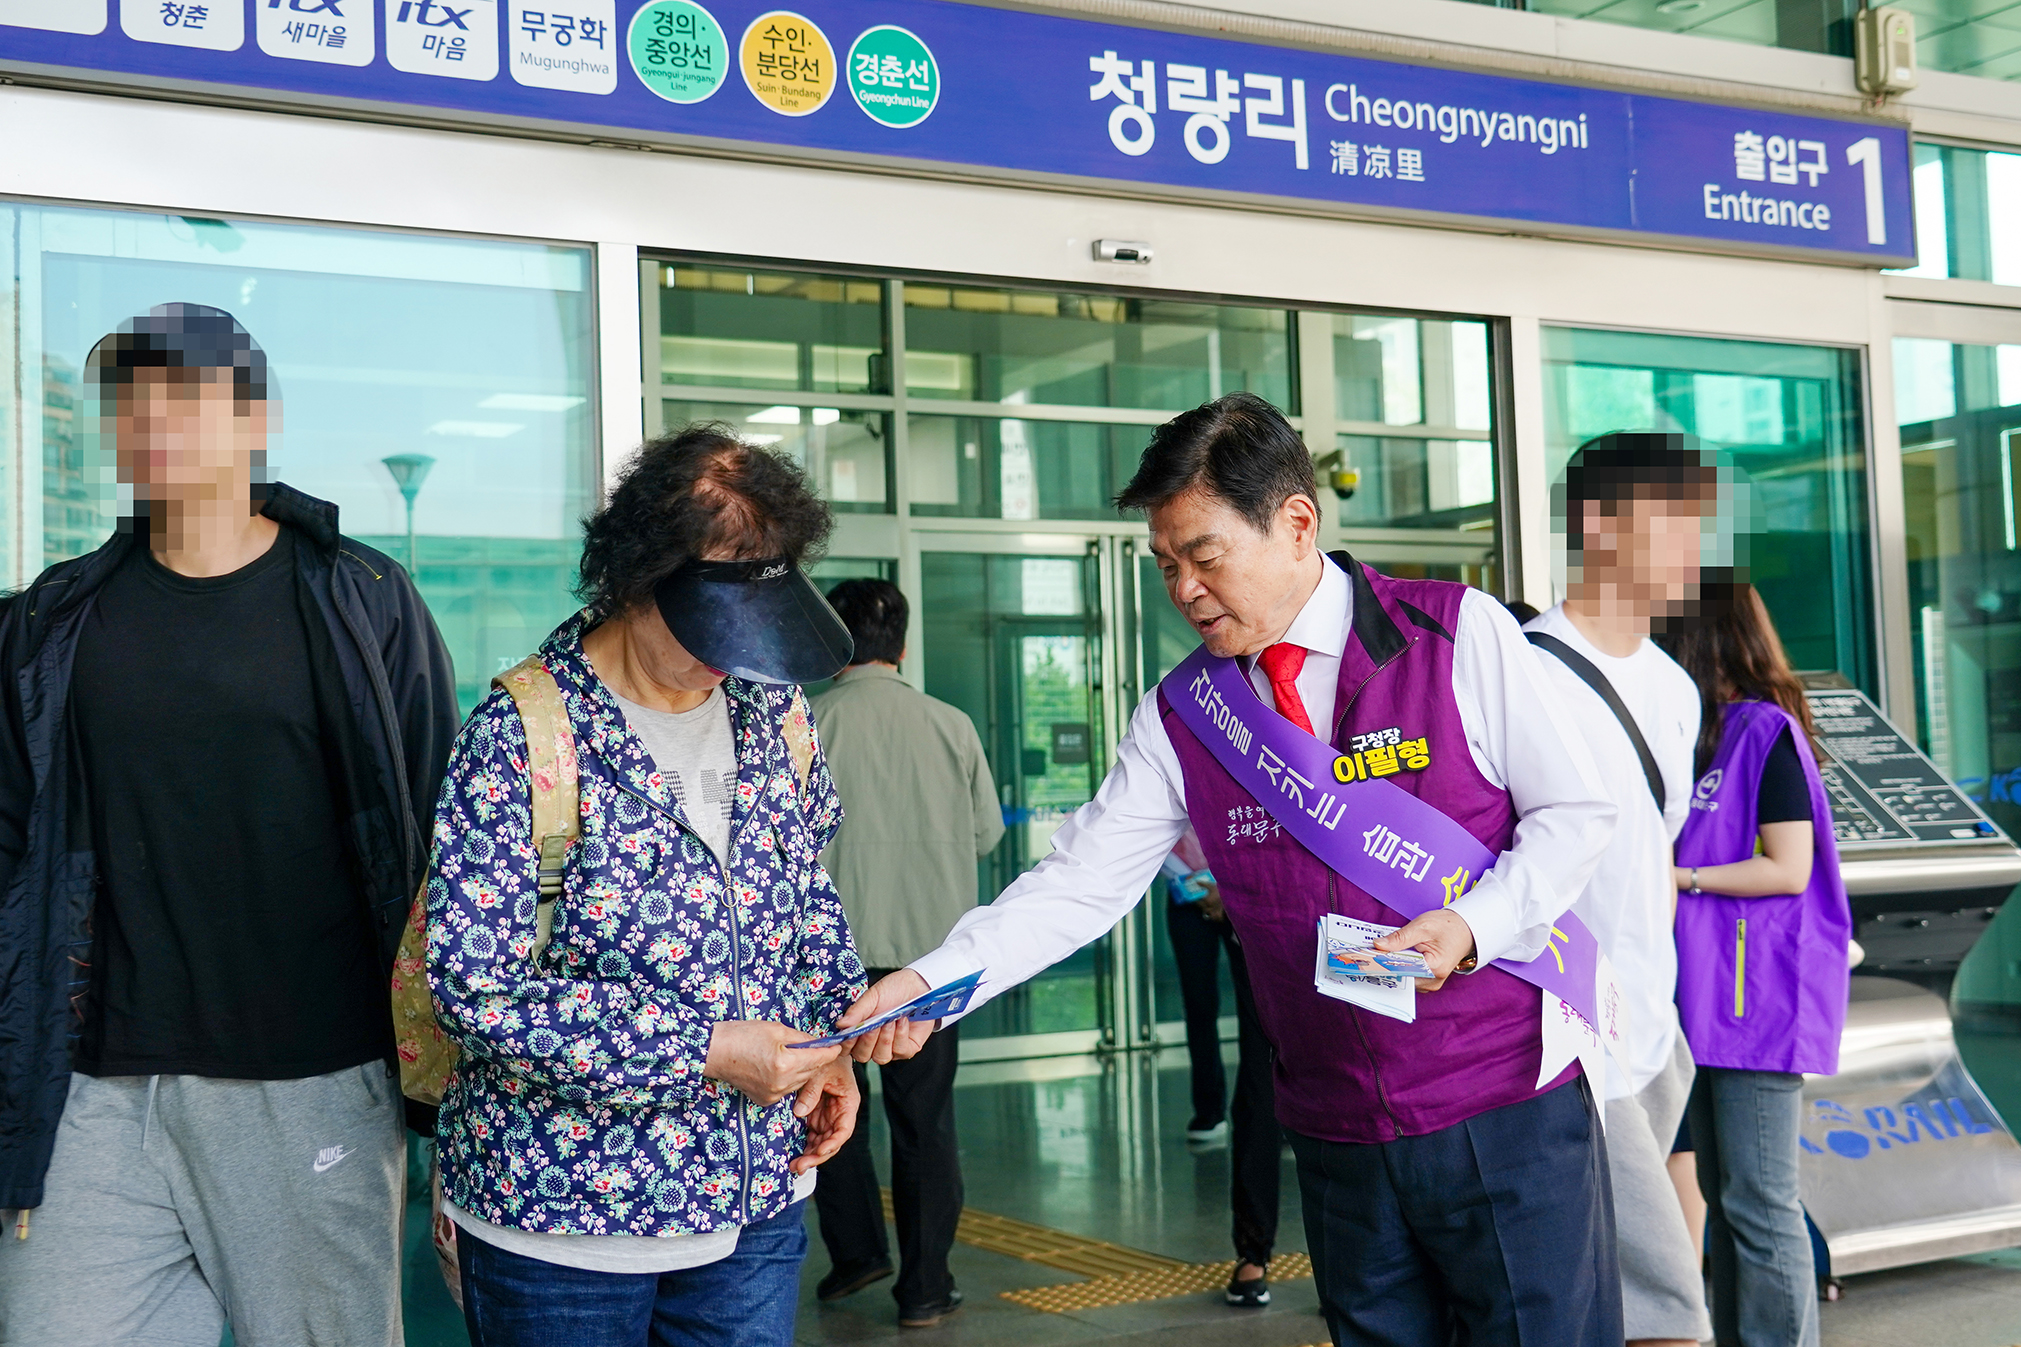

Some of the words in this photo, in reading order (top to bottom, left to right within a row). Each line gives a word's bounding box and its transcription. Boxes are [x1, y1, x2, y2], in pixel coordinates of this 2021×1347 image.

[159, 1, 209, 29] 청춘
[521, 10, 607, 50] 무궁화
[281, 20, 347, 48] 새마을
[422, 34, 467, 61] 마음
[519, 51, 610, 75] Mugunghwa
[645, 38, 713, 71] 중앙선
[756, 51, 820, 84] 분당선
[670, 81, 688, 92] Line
[855, 52, 930, 92] 경춘선
[780, 96, 799, 108] Line
[858, 89, 910, 108] Gyeongchun
[911, 95, 930, 109] Line
[1089, 50, 1309, 170] 청량리
[1325, 83, 1589, 155] Cheongnyangni
[1733, 130, 1829, 188] 출입구
[1845, 136, 1887, 245] 1
[1703, 184, 1831, 231] Entrance
[1351, 727, 1401, 752] 구청장
[1188, 667, 1253, 756] 건강을
[1256, 744, 1347, 831] 지키는
[1362, 823, 1435, 882] 습관
[1333, 737, 1430, 783] 이필형
[1227, 805, 1254, 822] 행복을
[318, 1144, 344, 1164] NIKE
